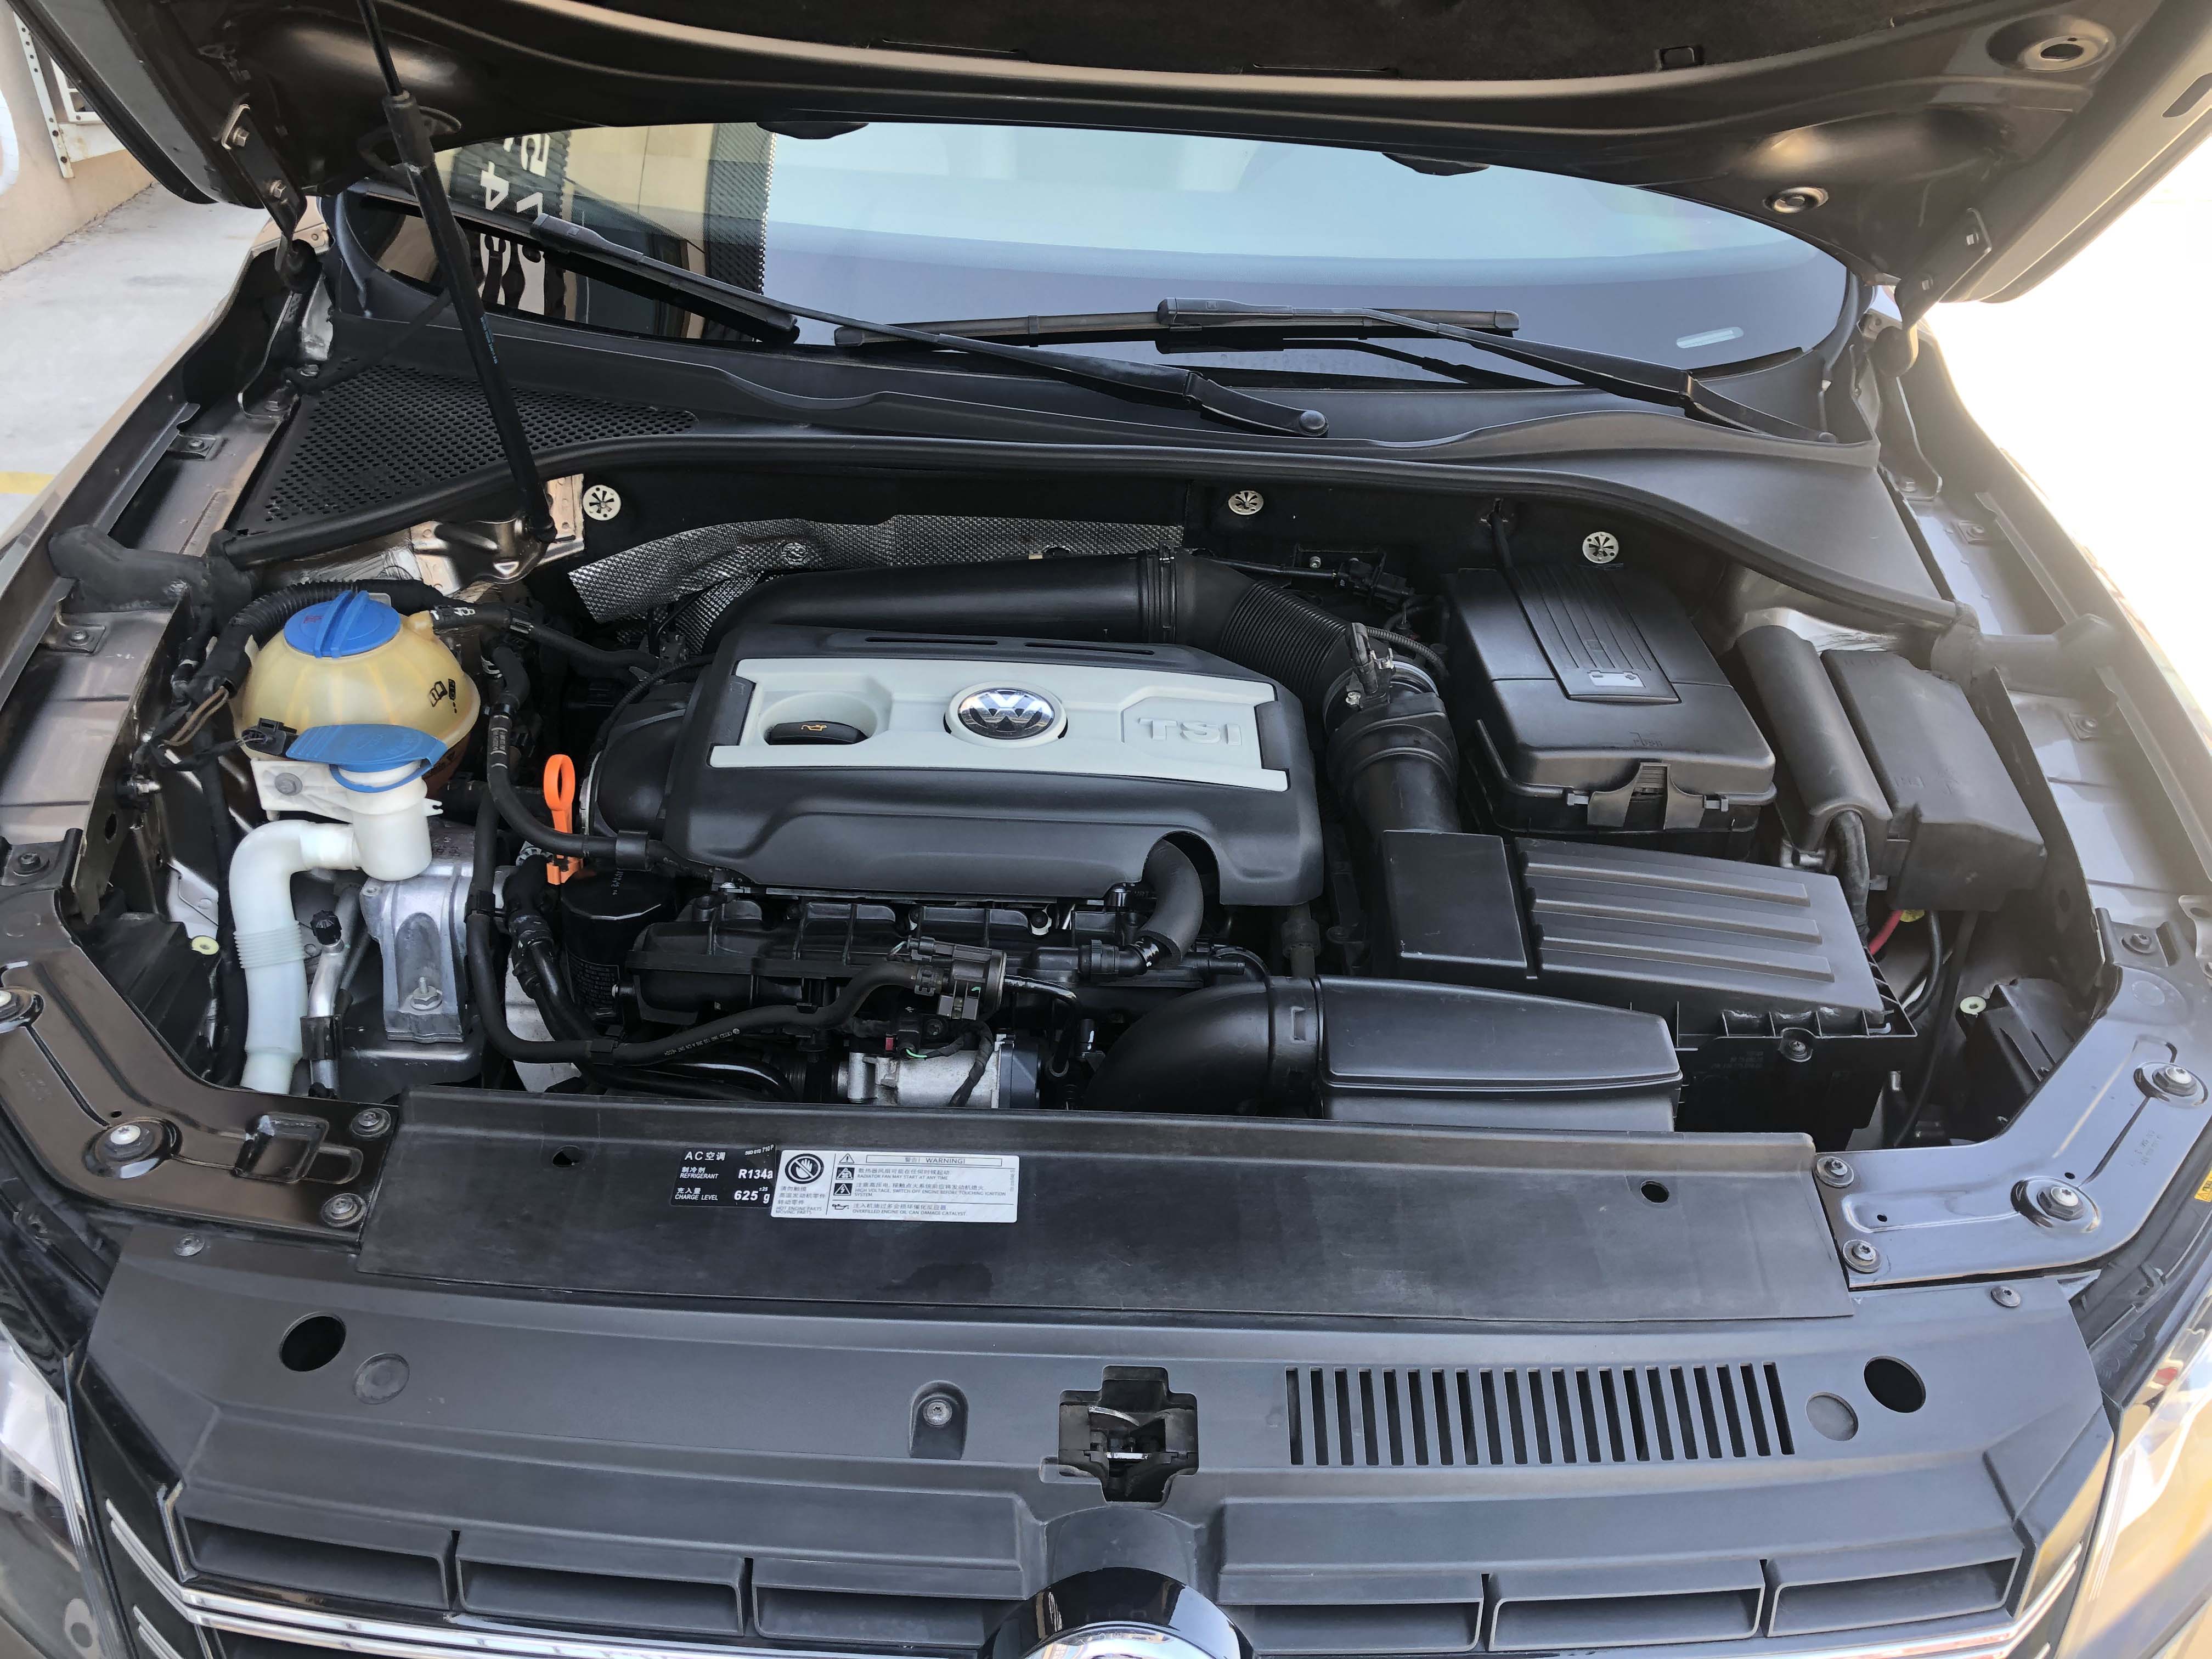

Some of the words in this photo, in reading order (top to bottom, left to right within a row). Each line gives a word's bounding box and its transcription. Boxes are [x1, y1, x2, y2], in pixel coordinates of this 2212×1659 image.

[1138, 717, 1243, 747] TSI
[685, 1151, 704, 1161] AC
[704, 1151, 726, 1161] 空调
[738, 1169, 774, 1180] R134a
[733, 1190, 759, 1201] 625
[763, 1193, 770, 1204] g
